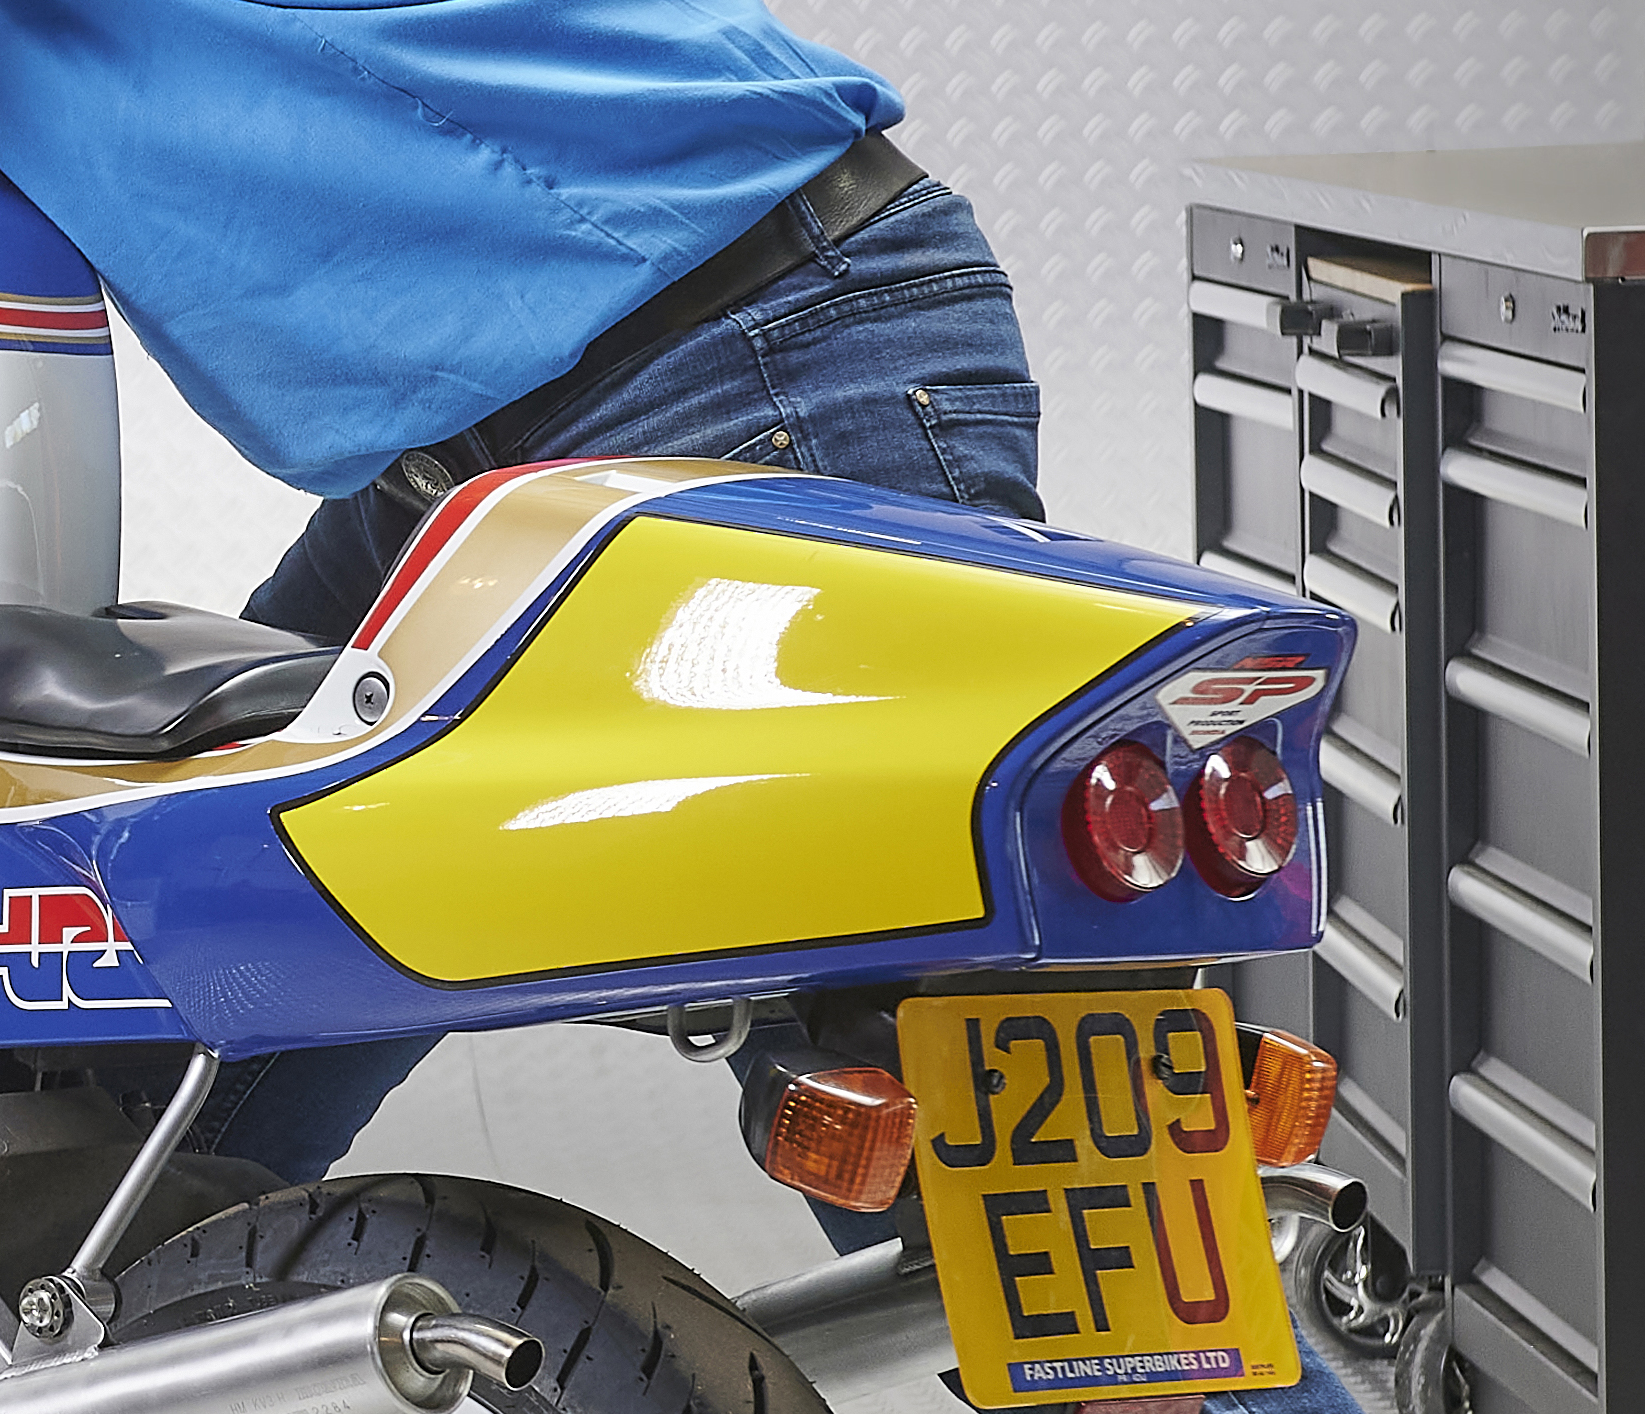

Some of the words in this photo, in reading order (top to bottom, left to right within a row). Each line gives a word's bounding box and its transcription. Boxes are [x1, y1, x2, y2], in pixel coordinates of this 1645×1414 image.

[1169, 675, 1316, 705] SP
[931, 1008, 1230, 1169] J209
[981, 1178, 1230, 1340] EFU
[1023, 1359, 1102, 1382] FASTLINE
[1104, 1351, 1200, 1376] SUPERBIKES
[1200, 1350, 1231, 1370] LTD
